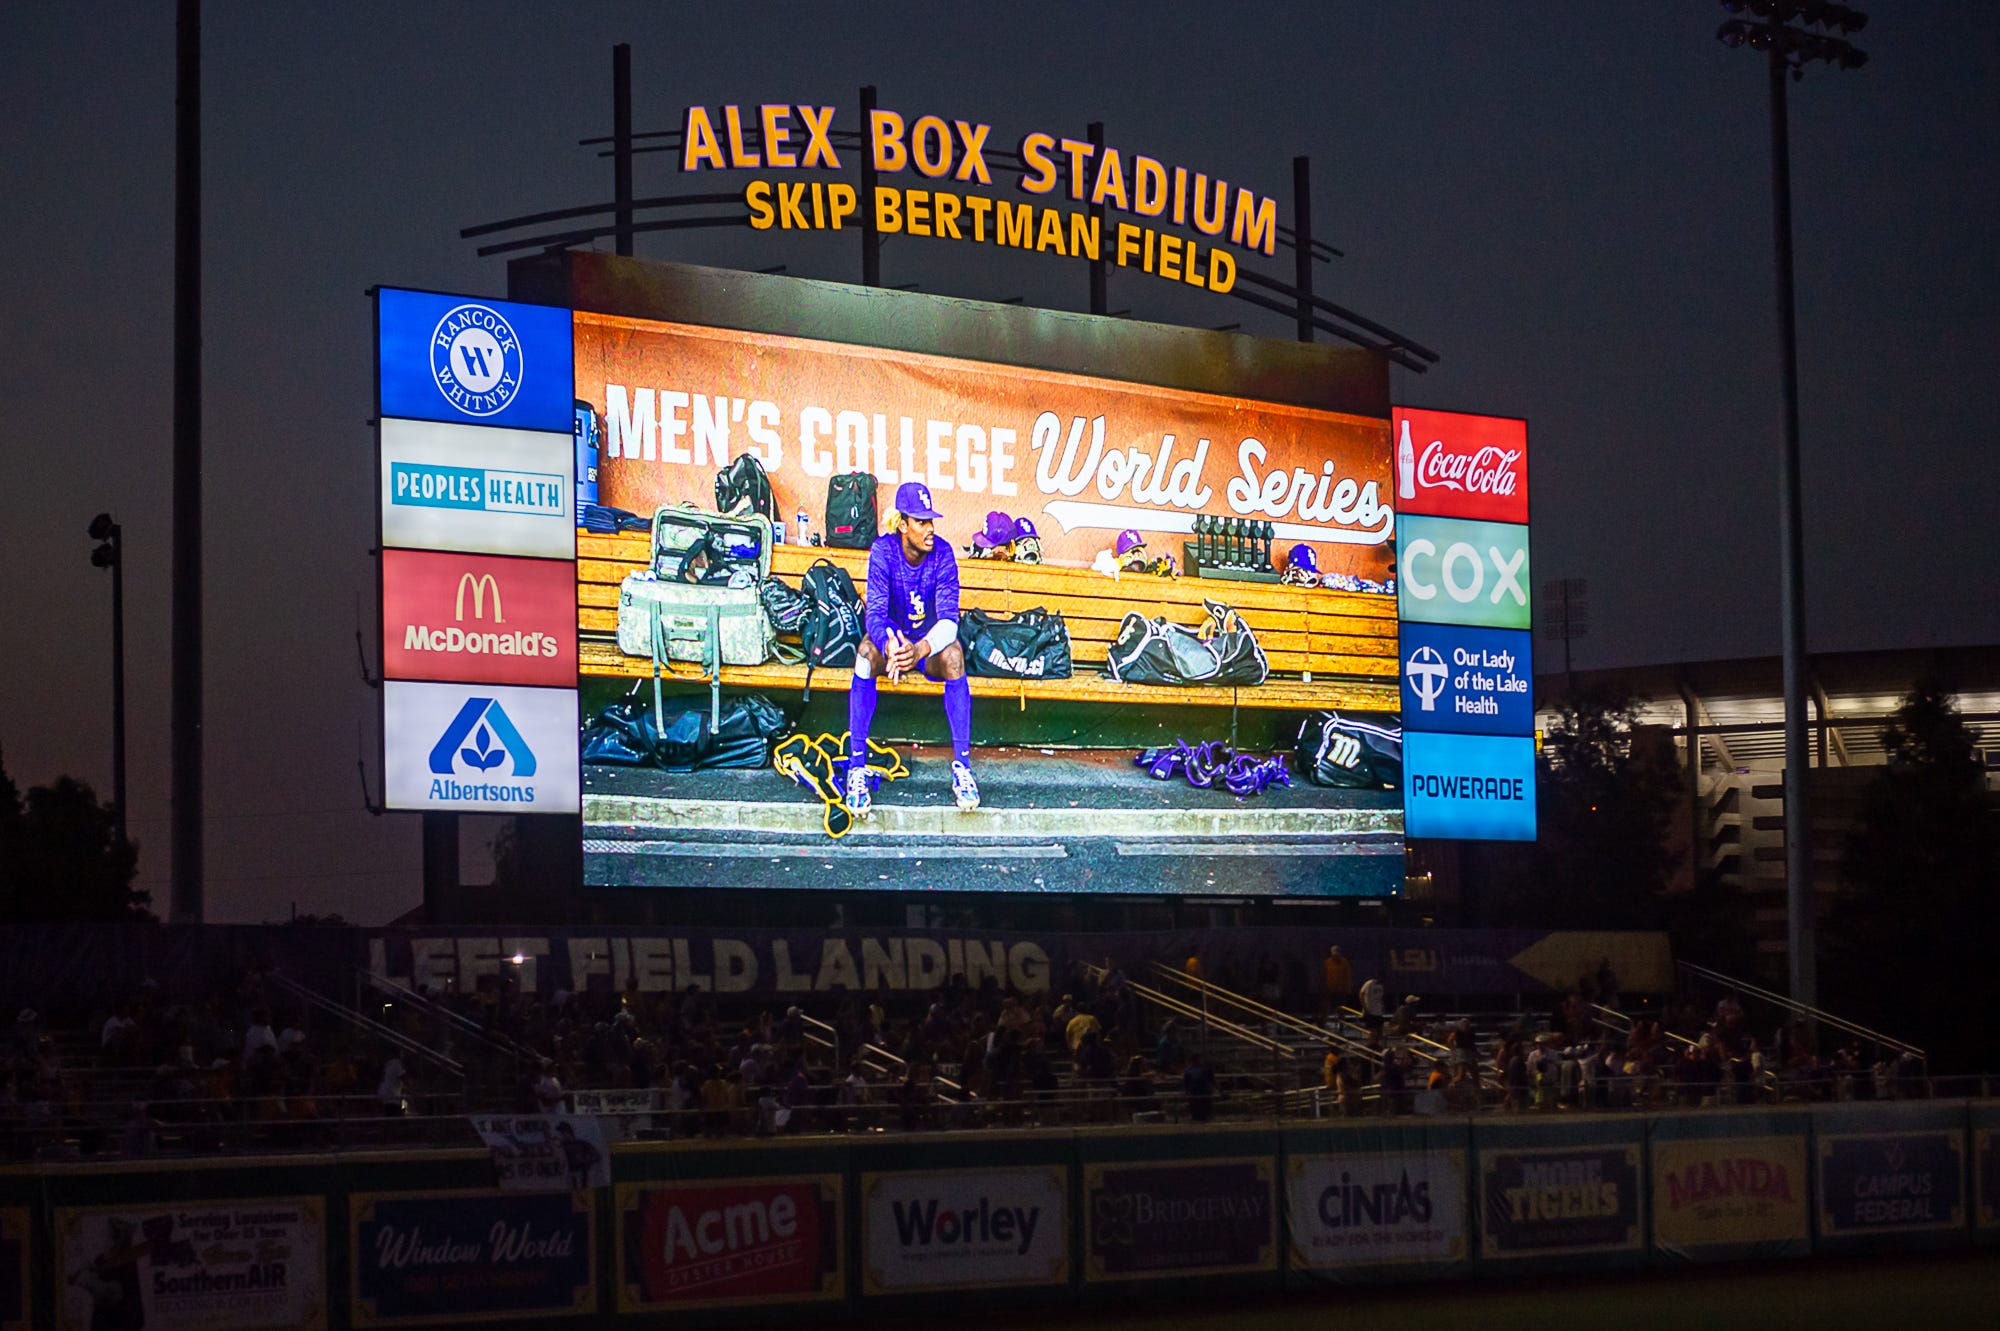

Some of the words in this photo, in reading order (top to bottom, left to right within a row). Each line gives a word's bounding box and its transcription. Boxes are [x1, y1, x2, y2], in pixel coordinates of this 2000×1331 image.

[683, 104, 841, 172] ALEX
[869, 108, 992, 185] BOX
[1020, 132, 1276, 256] STADIUM
[745, 180, 857, 231] SKIP
[874, 186, 1100, 261] BERTMAN
[1116, 222, 1237, 294] FIELD
[437, 311, 516, 355] HANCOCK
[438, 366, 516, 411] WHITNEY
[605, 384, 783, 473] MEN'S
[798, 406, 1018, 497] COLLEGE
[1031, 411, 1212, 510] World
[1226, 437, 1394, 528] Series
[1417, 441, 1522, 496] Coca-Cola
[397, 471, 481, 502] PEOPLES
[490, 479, 559, 508] HEALTH
[1402, 538, 1526, 607] COX
[403, 625, 558, 658] McDonald's
[1453, 647, 1479, 666] Our
[1483, 649, 1515, 673] Lady
[1454, 671, 1470, 690] of
[1472, 673, 1494, 692] the
[1497, 674, 1527, 693] Lake
[1455, 695, 1498, 715] Health
[429, 779, 534, 803] Albertsons
[1412, 774, 1523, 801] POWERADE
[367, 937, 550, 993] LEFT
[568, 937, 759, 993] FIELD
[772, 937, 1050, 995] LANDING
[1390, 948, 1438, 972] LSU
[1665, 1158, 1793, 1212] MANDA
[1853, 1172, 1933, 1198] CAMPUS
[892, 1197, 1040, 1256] Worley
[1135, 1192, 1265, 1224] BRIDGEWAY
[1853, 1198, 1935, 1223] FEDERAL
[375, 1224, 482, 1269] Window
[488, 1219, 575, 1264] World
[664, 1193, 798, 1265] Acme
[153, 1263, 287, 1295] SouthernAIR
[669, 1259, 734, 1286] OYSTER
[742, 1245, 796, 1270] HOUSE
